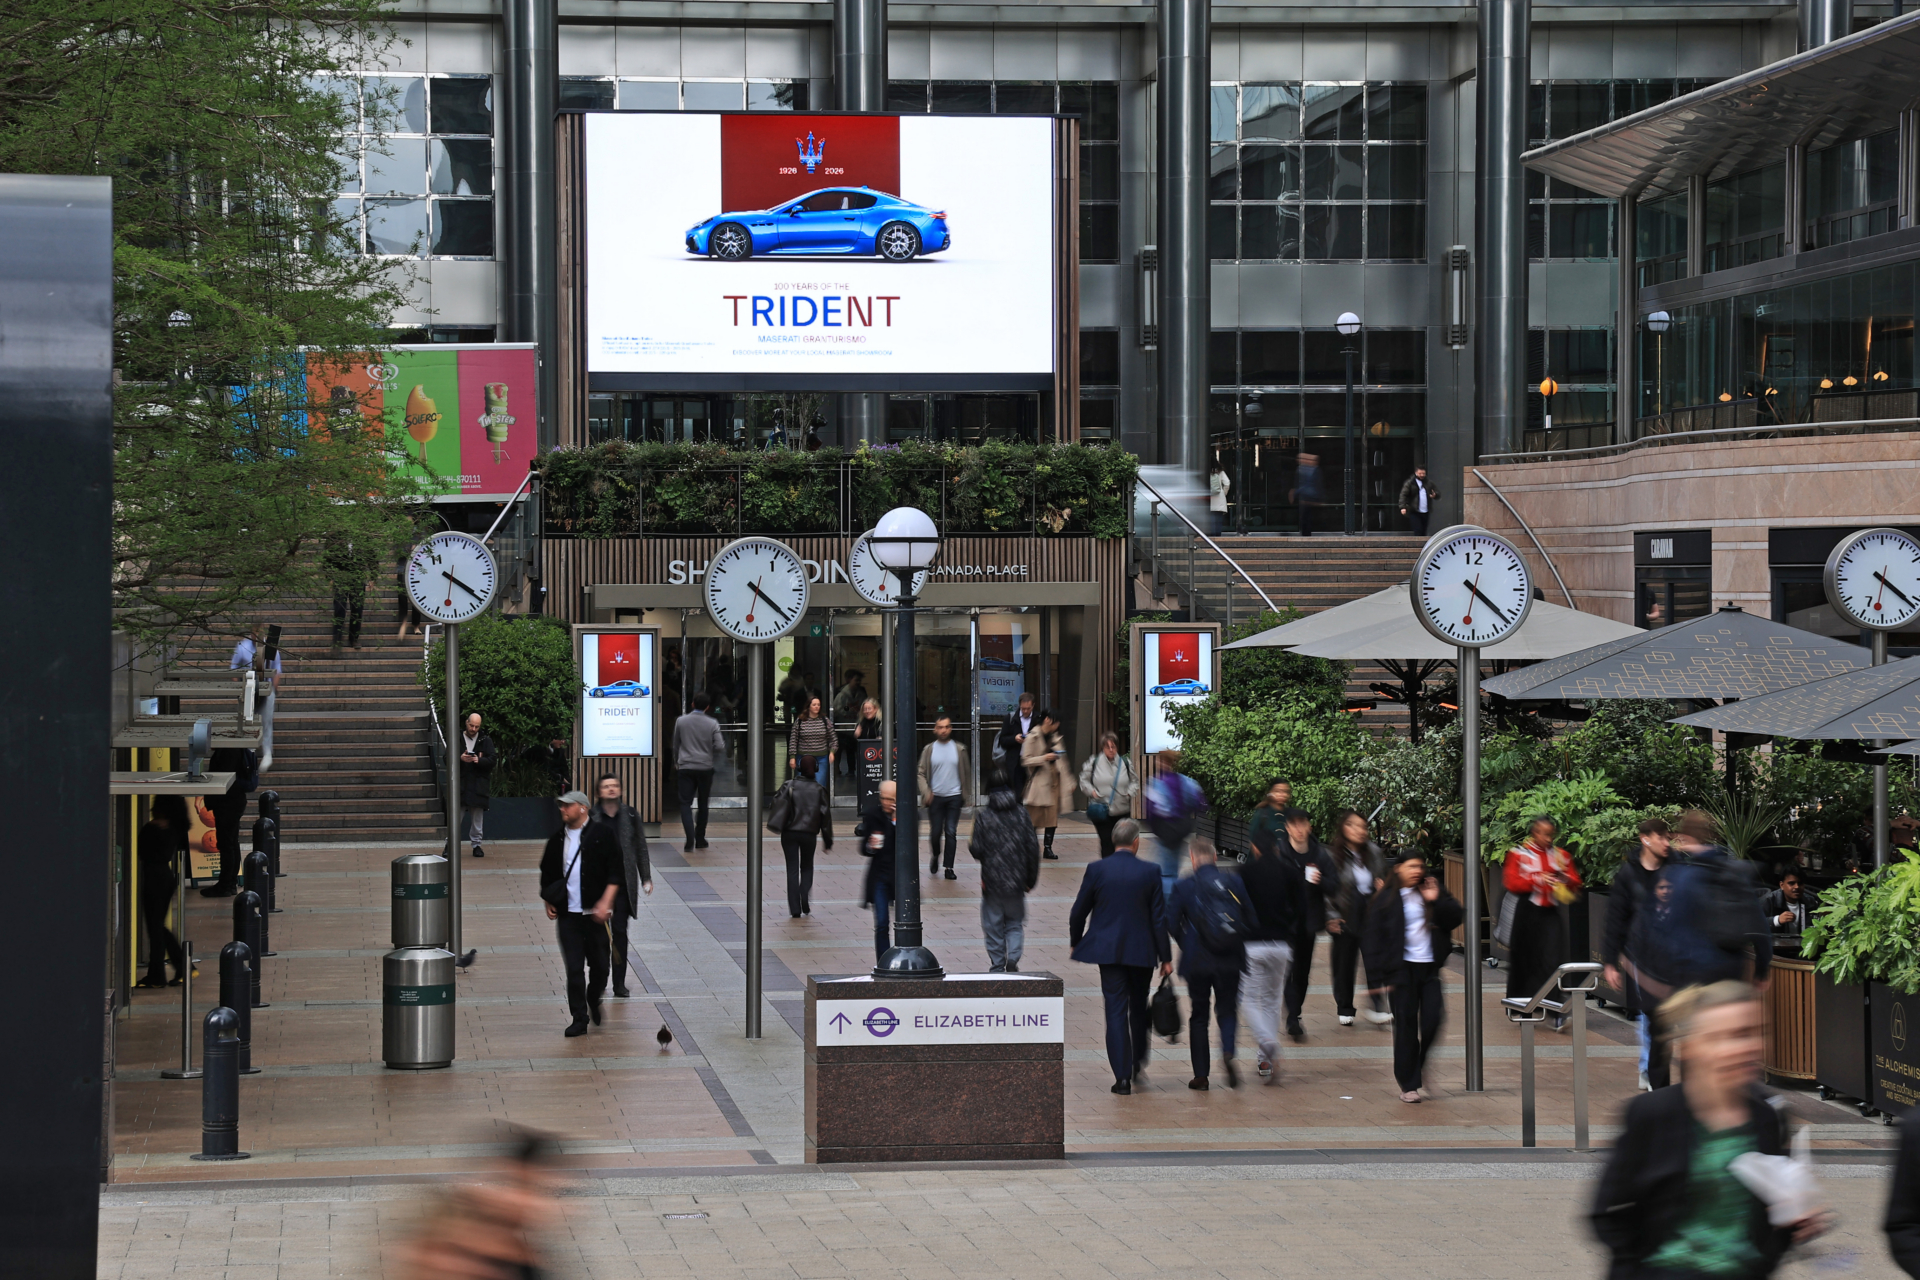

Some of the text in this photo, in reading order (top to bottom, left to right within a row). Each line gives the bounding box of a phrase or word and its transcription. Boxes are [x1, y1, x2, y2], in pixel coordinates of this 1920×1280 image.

[825, 167, 844, 175] 2026
[723, 295, 900, 327] TRIDENT
[758, 335, 867, 343] MASERATI GRANTURISMO
[1465, 552, 1483, 565] 12
[770, 560, 775, 572] 1
[928, 564, 983, 576] CANADA
[986, 564, 1028, 576] PLACE
[1865, 595, 1873, 607] 7
[598, 707, 641, 717] TRIDENT
[914, 1013, 1050, 1028] ELIZABETH LINE
[1875, 1054, 1920, 1080] THE ALCHEMIS
[1886, 1090, 1916, 1107] AND RESTAURANT
